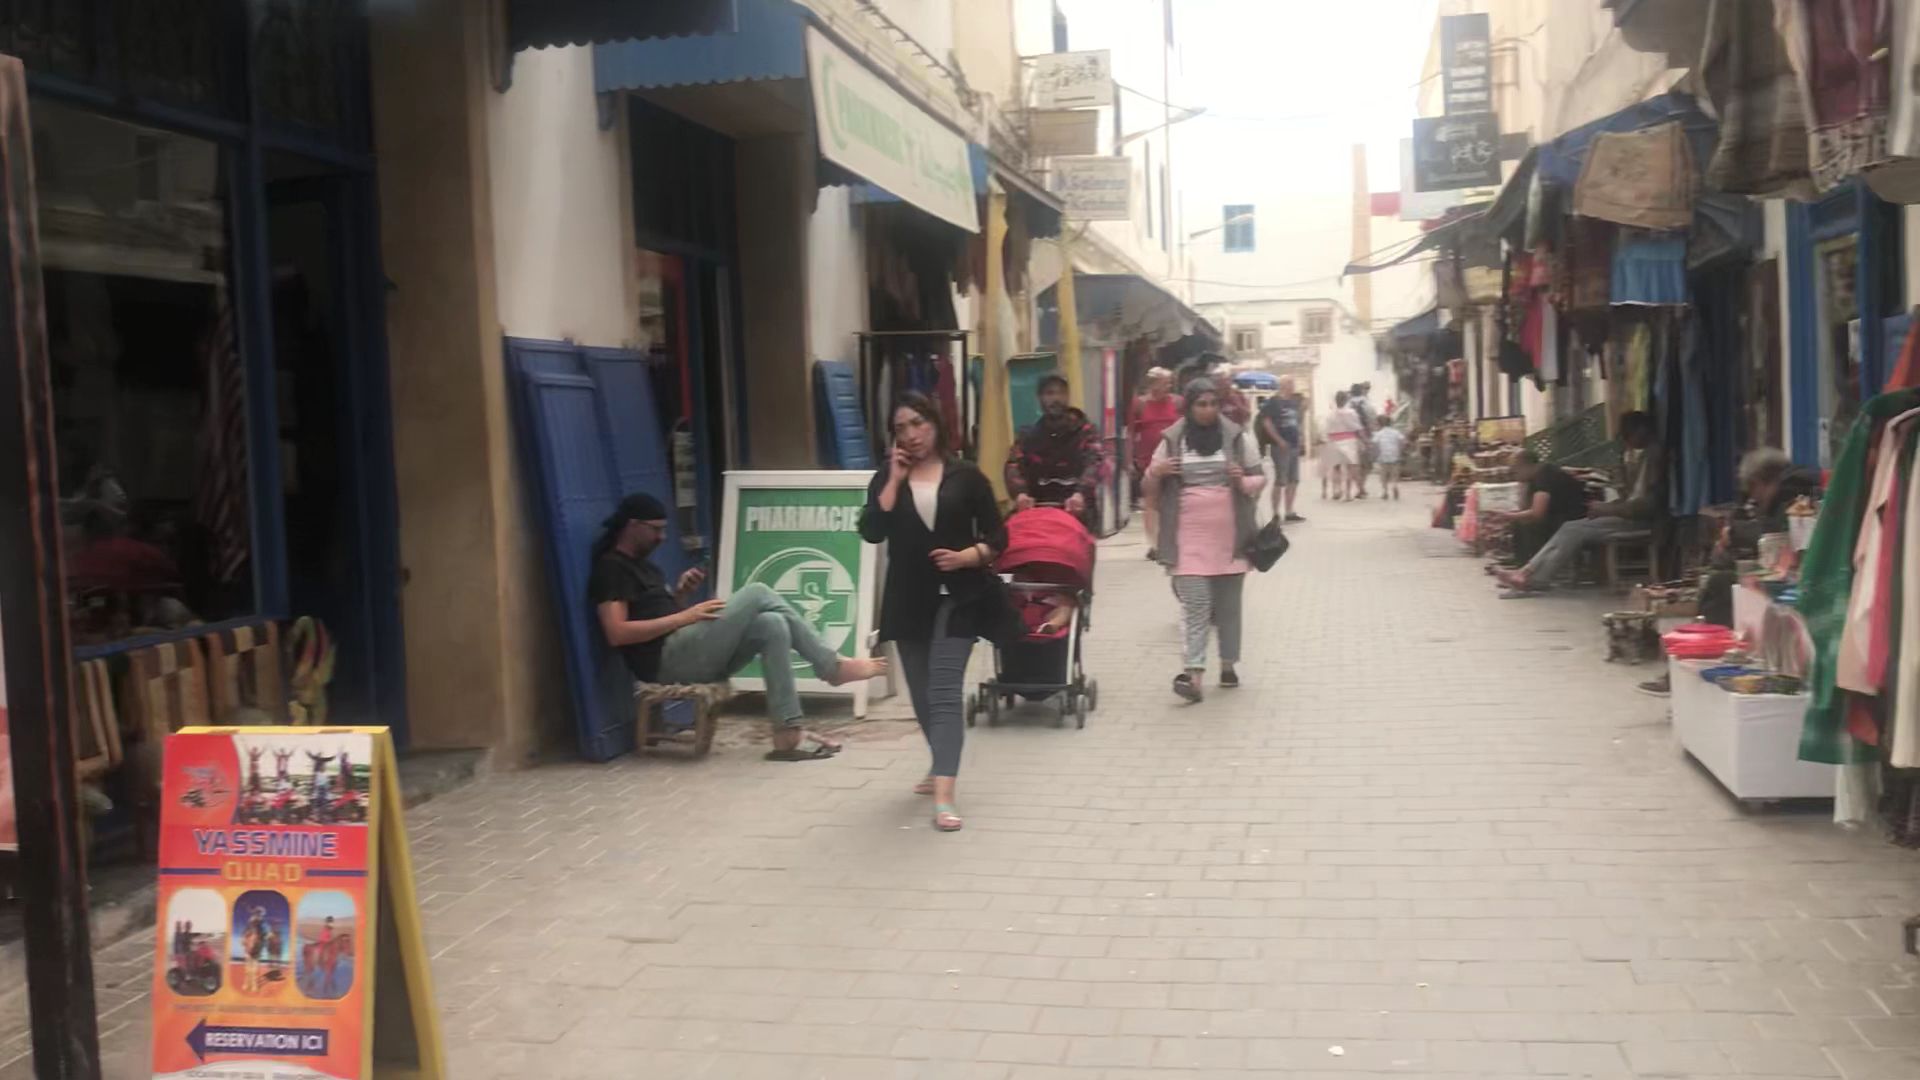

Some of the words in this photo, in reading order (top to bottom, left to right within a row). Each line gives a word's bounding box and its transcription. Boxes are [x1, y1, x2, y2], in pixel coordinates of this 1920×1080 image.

[745, 506, 862, 532] PHARMACIE
[193, 828, 338, 859] YASSMINE
[223, 860, 302, 883] QUAD
[204, 1031, 299, 1050] RESERVATION
[302, 1034, 323, 1051] ICI
